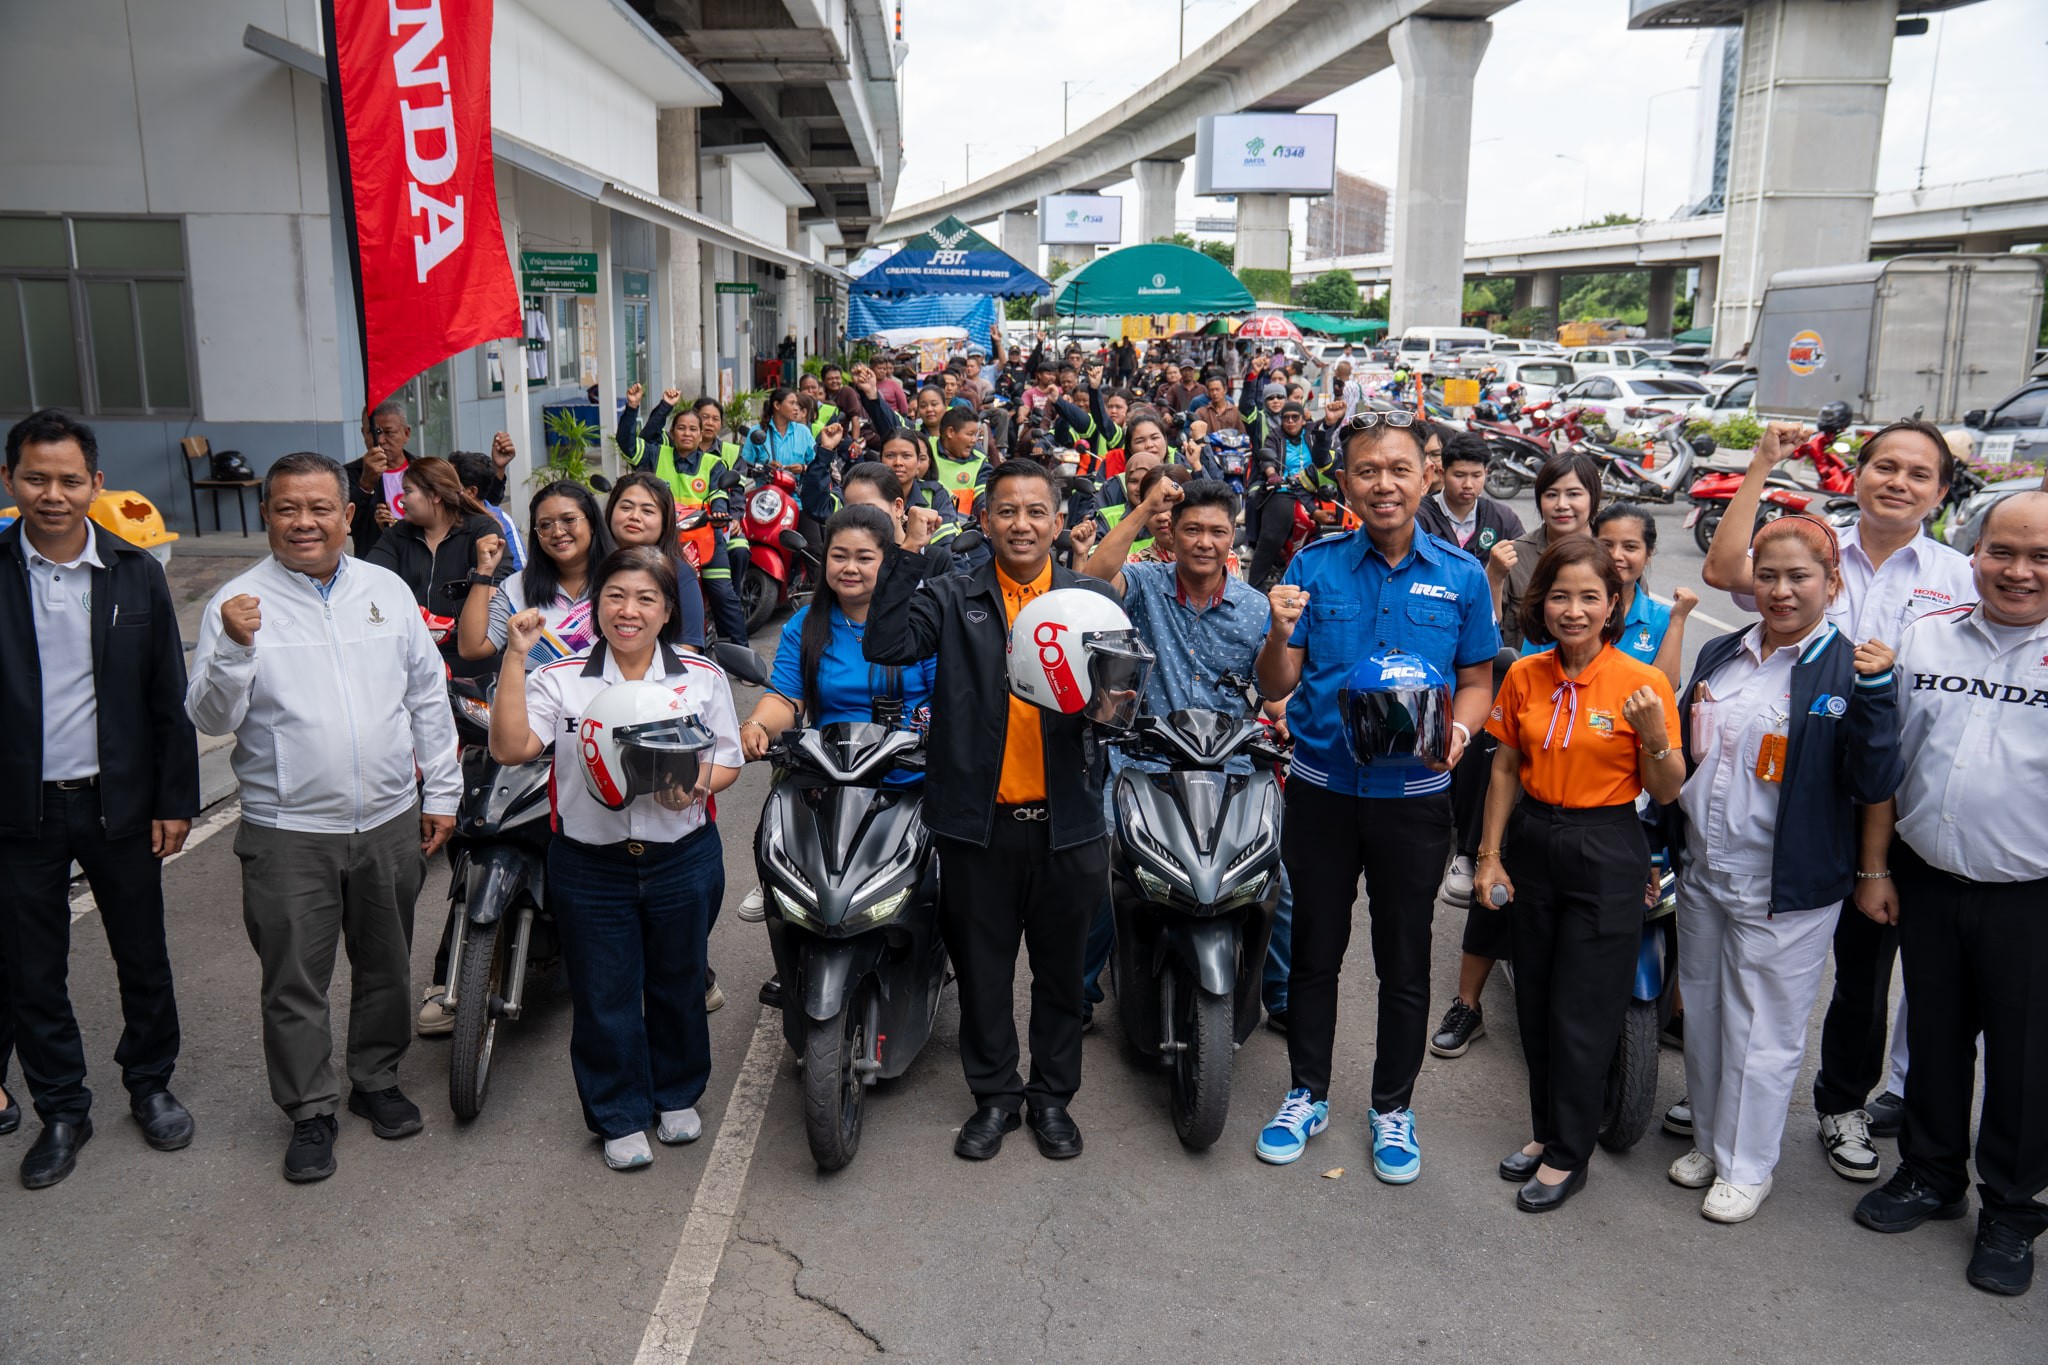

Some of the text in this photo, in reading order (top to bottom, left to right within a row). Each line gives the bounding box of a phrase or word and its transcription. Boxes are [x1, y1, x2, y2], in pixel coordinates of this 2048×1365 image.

[885, 267, 1010, 278] CREATING EXCELLENCE IN SPORTS
[1409, 582, 1460, 601] IRC TIRE
[1913, 588, 1951, 601] HONDA
[1380, 667, 1416, 681] IRC
[1913, 673, 2048, 709] HONDA
